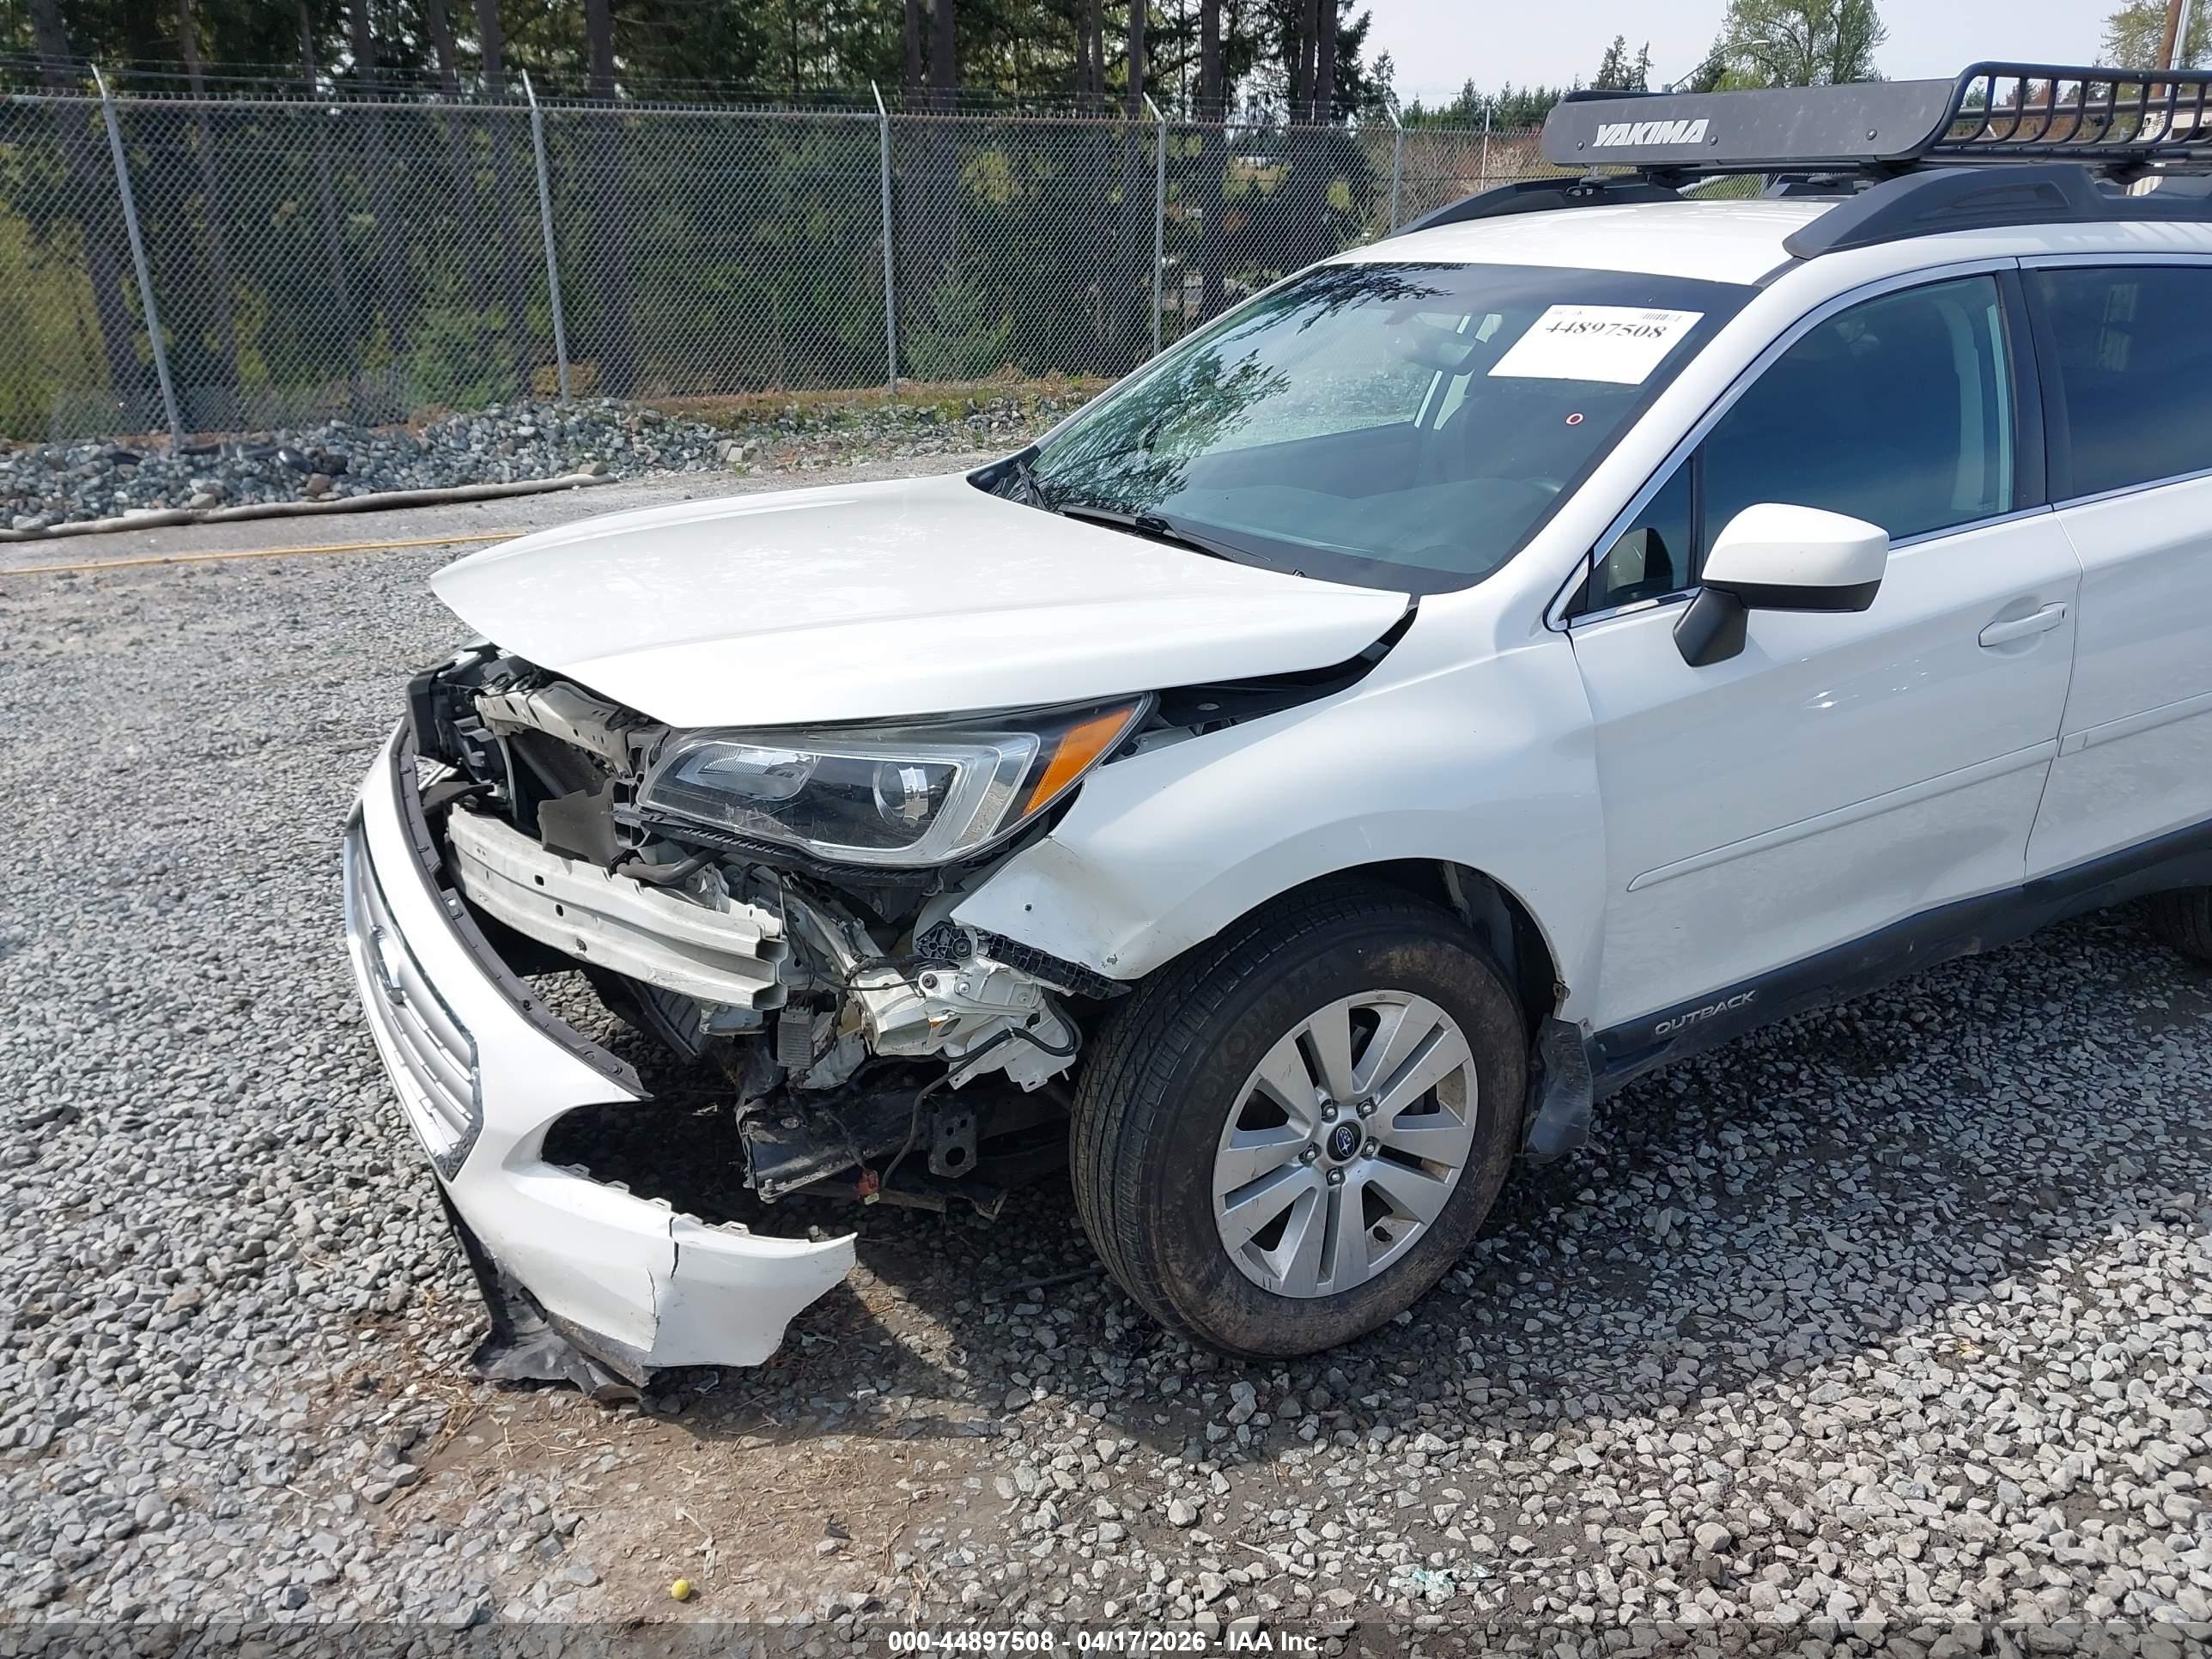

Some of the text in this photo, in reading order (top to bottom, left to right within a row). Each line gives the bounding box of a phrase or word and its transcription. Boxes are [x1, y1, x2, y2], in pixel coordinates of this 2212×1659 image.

[1592, 118, 1710, 148] YAKIMA
[1545, 320, 1668, 338] 44897508
[1655, 989, 1757, 1036] OUTBACK
